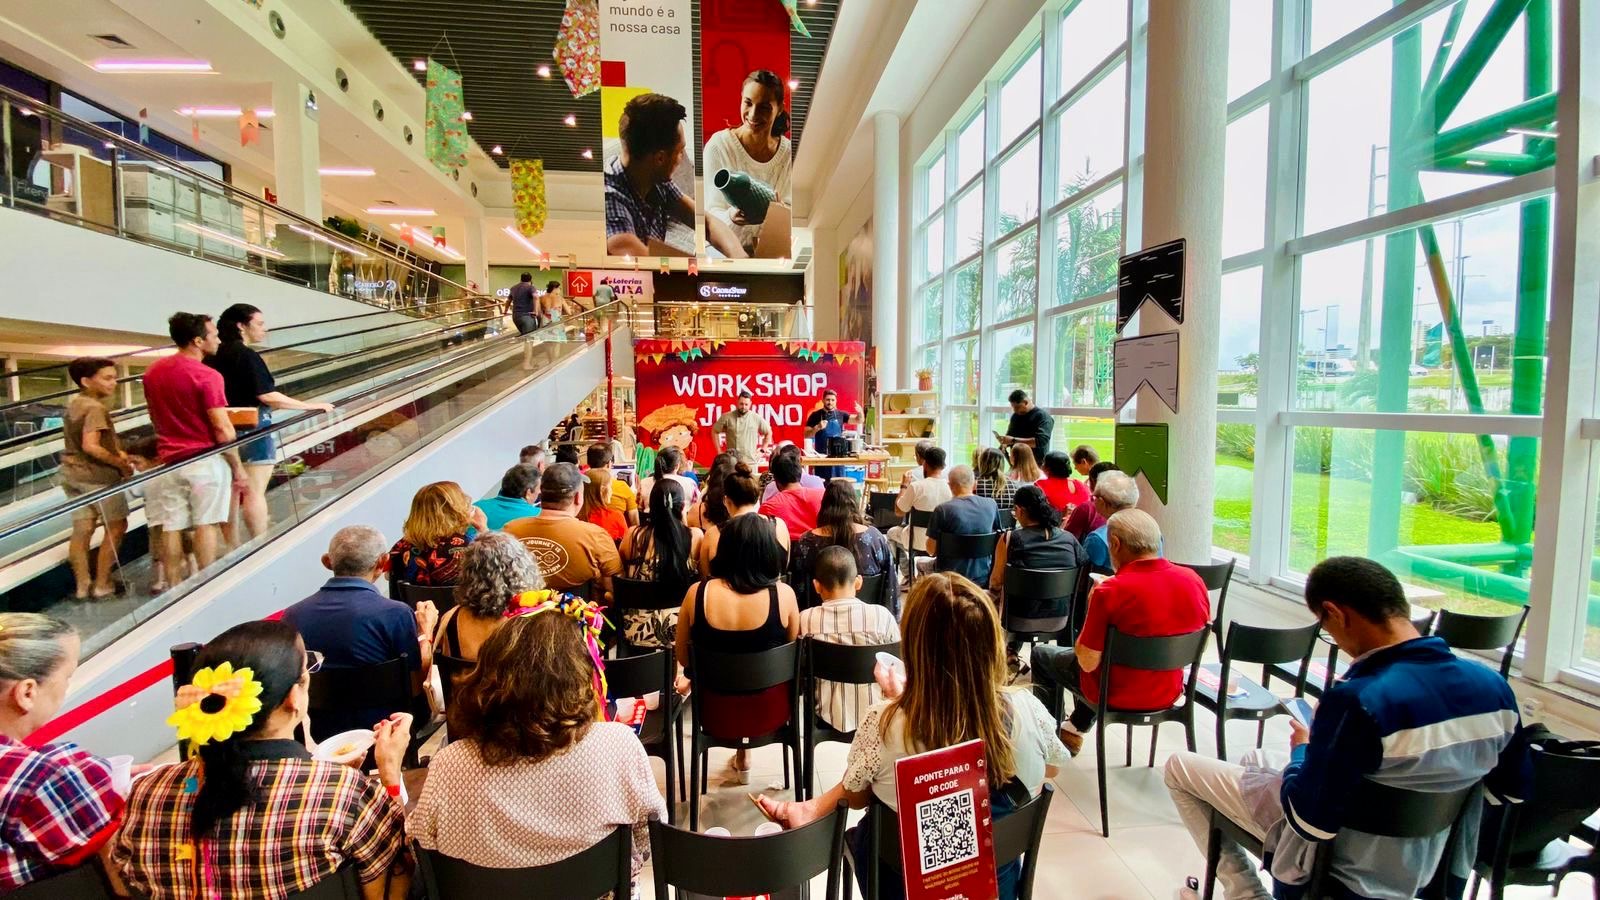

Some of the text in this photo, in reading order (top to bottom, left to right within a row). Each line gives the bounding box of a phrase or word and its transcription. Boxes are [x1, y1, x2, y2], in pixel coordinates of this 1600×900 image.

[609, 5, 675, 18] mundo é a
[609, 22, 681, 35] nossa casa
[612, 277, 642, 285] Loterias
[613, 285, 644, 295] AIXA
[672, 372, 828, 398] WORKSHOP
[526, 539, 555, 549] JOURNEY
[913, 763, 970, 785] APONTE PARA O
[928, 779, 959, 795] QR CODE
